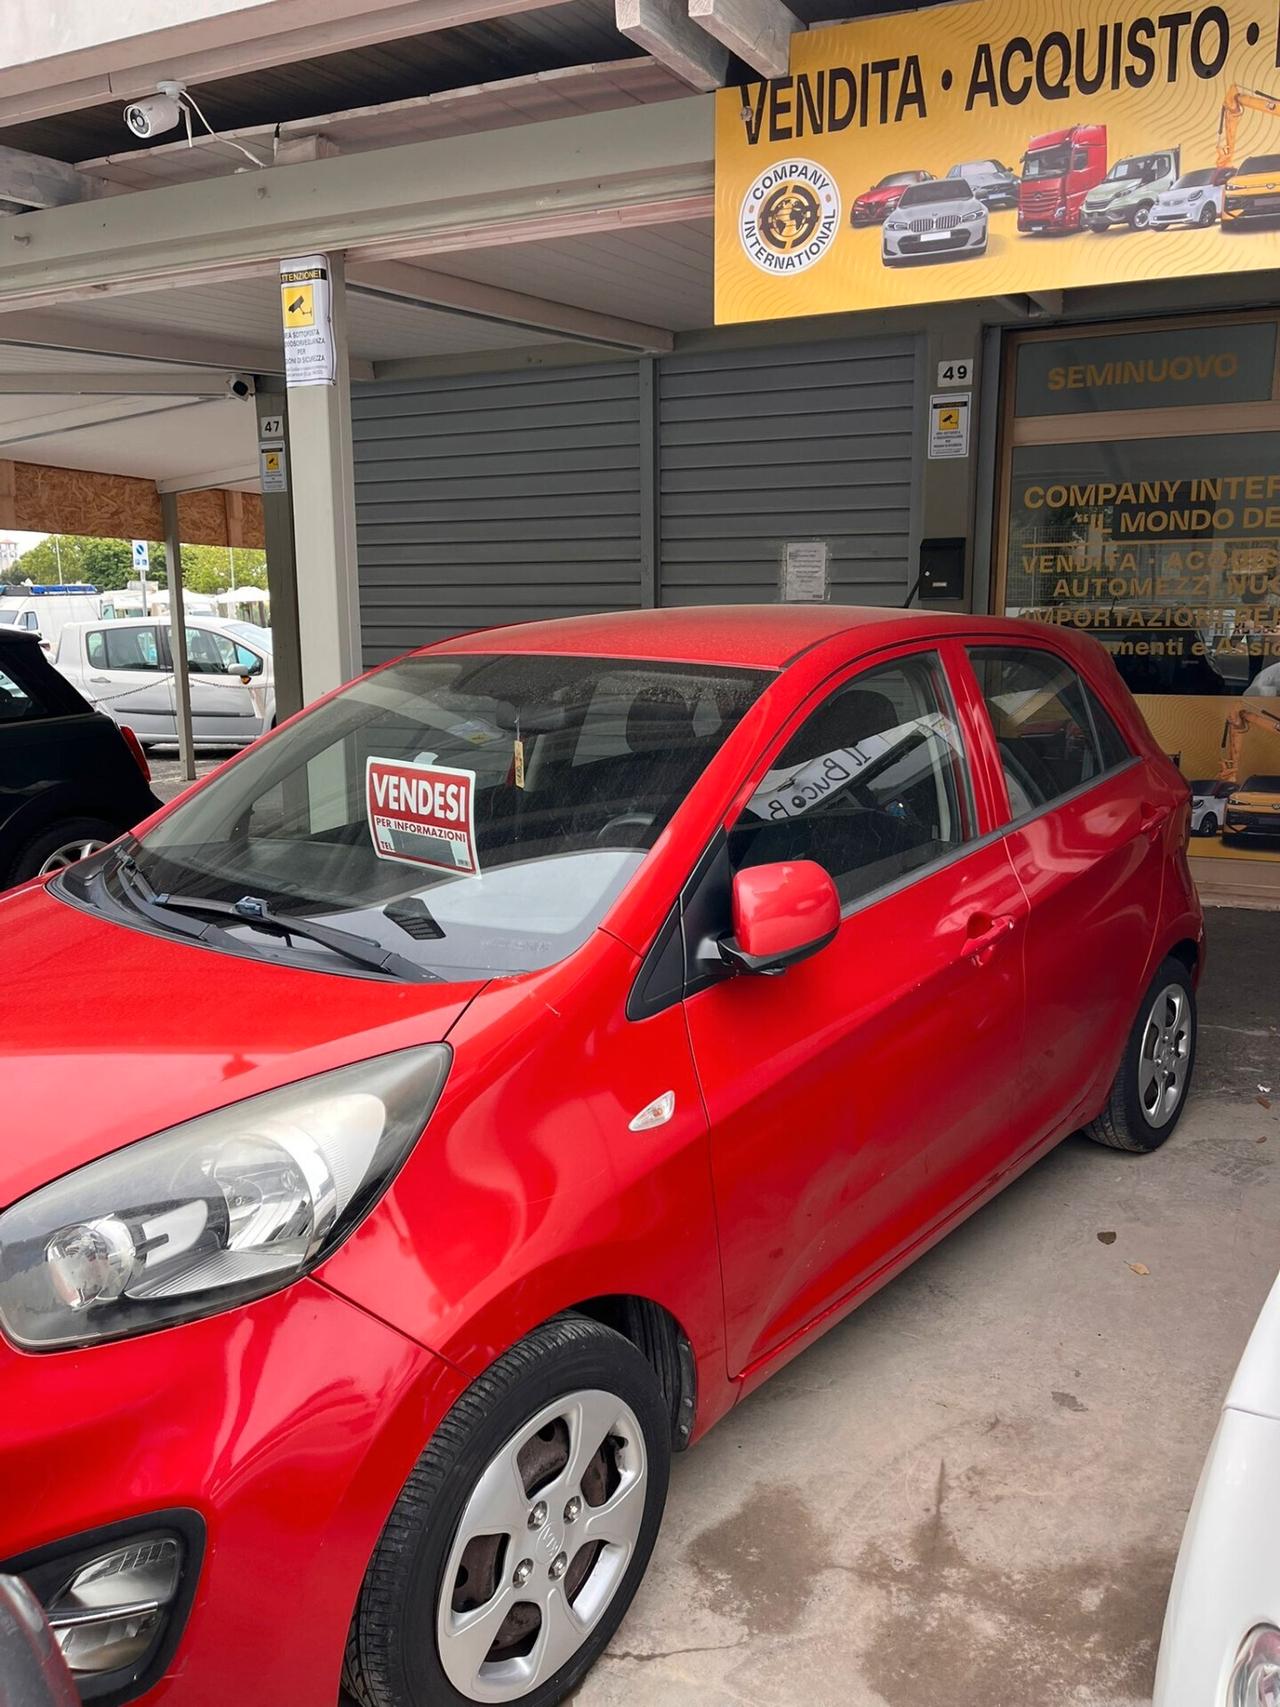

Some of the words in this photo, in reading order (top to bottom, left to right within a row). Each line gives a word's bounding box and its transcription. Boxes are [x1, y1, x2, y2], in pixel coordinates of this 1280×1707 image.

[740, 55, 926, 145] VENDITA
[965, 6, 1229, 111] ACQUISTO
[752, 164, 830, 201] COMPANY
[744, 209, 836, 269] INTERNATIONAL
[942, 365, 968, 381] 49
[1047, 352, 1239, 391] SEMINUOVO
[264, 421, 280, 432] 47
[1023, 480, 1184, 509] COMPANY
[1120, 508, 1234, 533] MONDO
[1243, 507, 1280, 529] DE
[1023, 552, 1136, 574] VENDITA
[1053, 575, 1216, 598] AUTOMEZZI
[1191, 641, 1205, 656] e
[371, 772, 466, 823] VENDESI
[376, 817, 393, 828] PER
[394, 821, 466, 843] INFORMAZIONI
